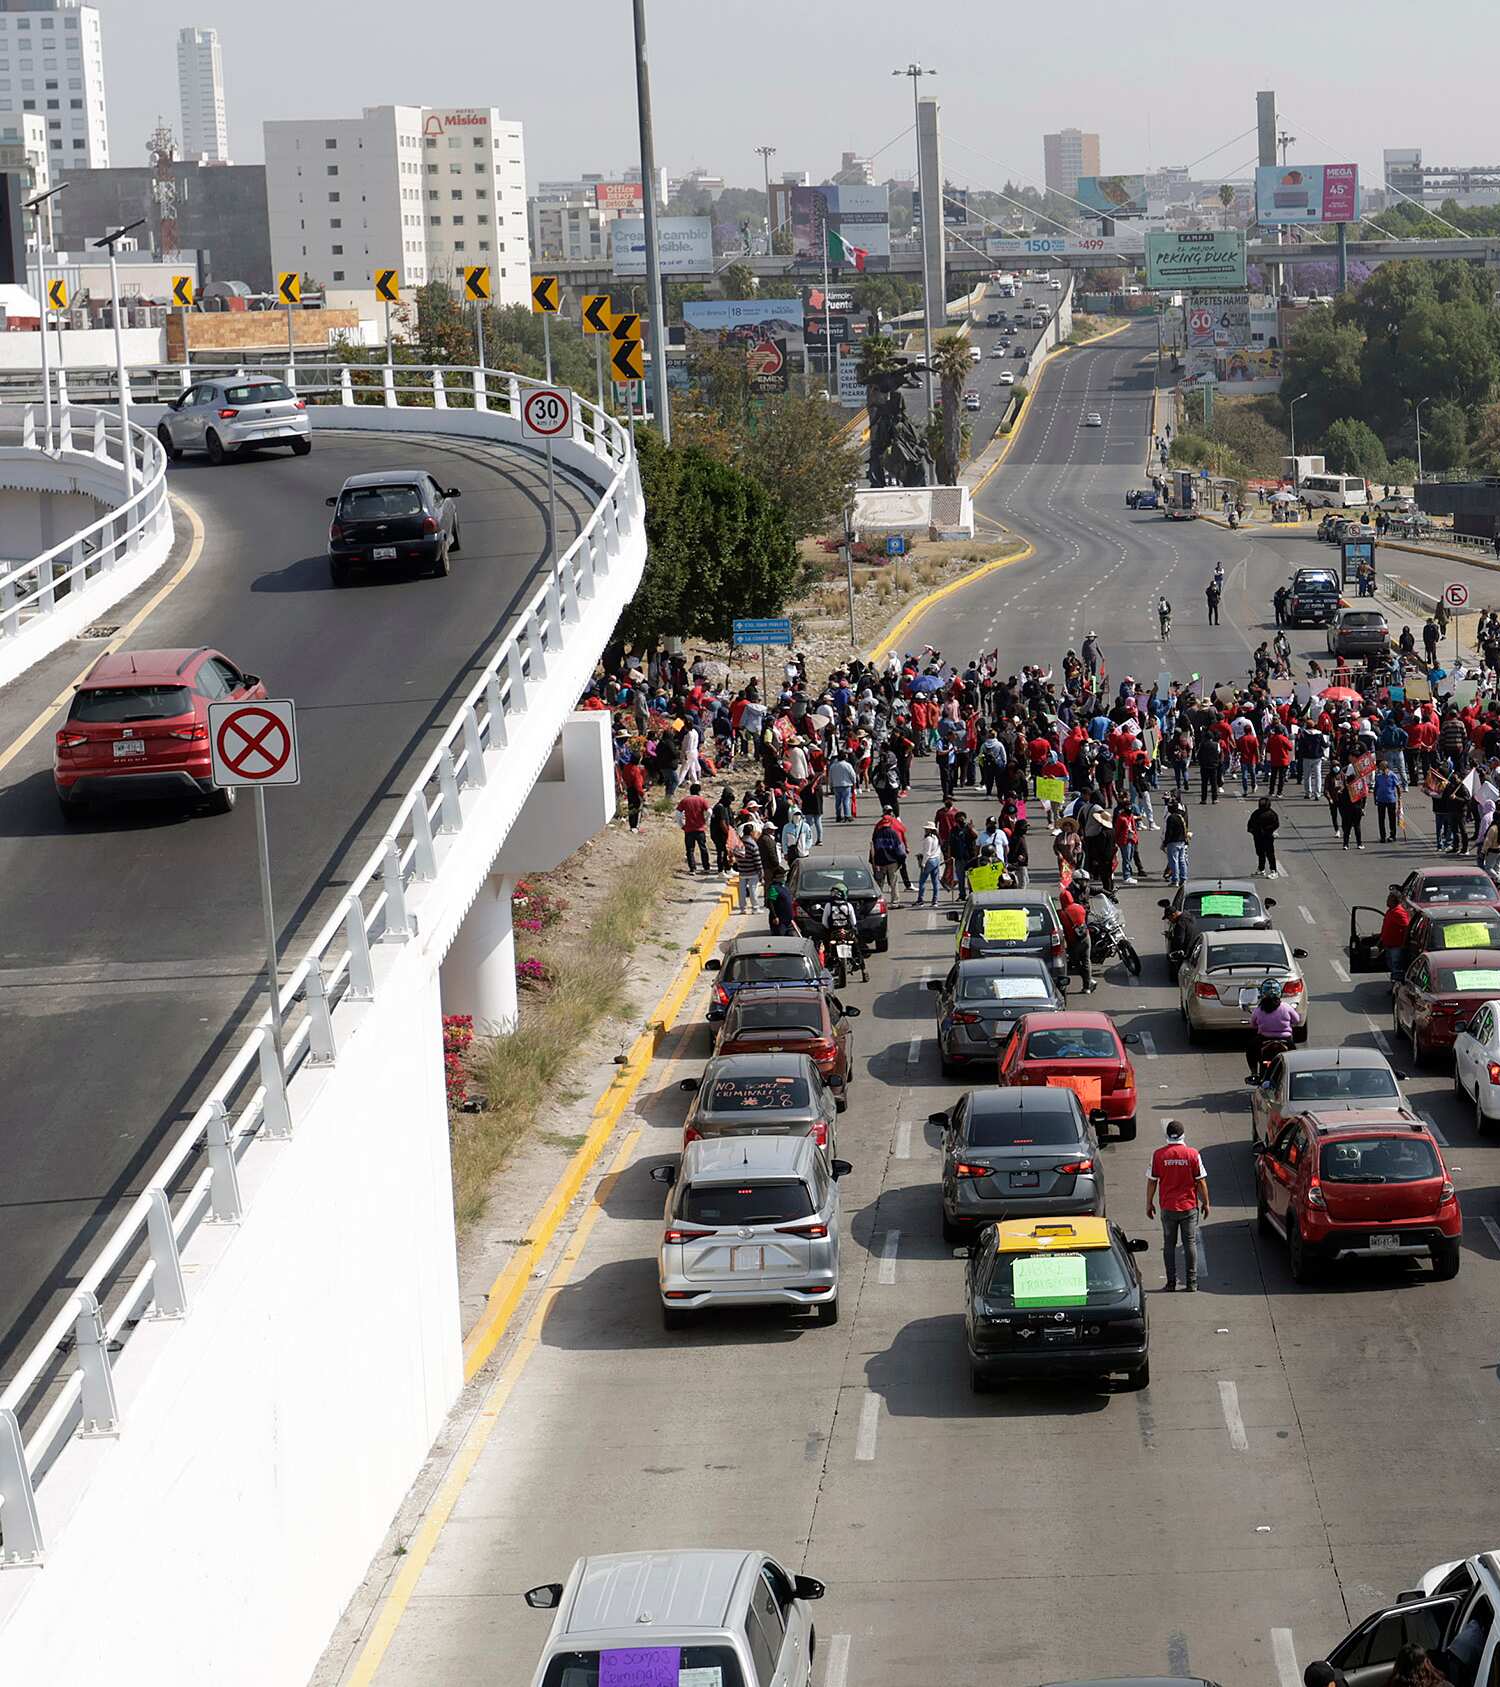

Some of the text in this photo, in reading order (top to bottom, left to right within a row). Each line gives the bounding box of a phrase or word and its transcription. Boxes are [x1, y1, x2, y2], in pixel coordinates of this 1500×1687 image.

[444, 114, 487, 126] Misión
[1326, 168, 1353, 177] MEGA
[606, 186, 635, 194] Office
[663, 229, 708, 241] cambio
[615, 244, 629, 253] es
[1024, 240, 1050, 252] 150
[1078, 239, 1104, 250] $499
[1156, 251, 1238, 265] PEKING DUCK
[1190, 295, 1249, 306] TAPETES HAMID
[731, 307, 742, 317] 18
[1190, 313, 1212, 329] 60
[535, 399, 559, 420] 30
[715, 1082, 736, 1091] NO
